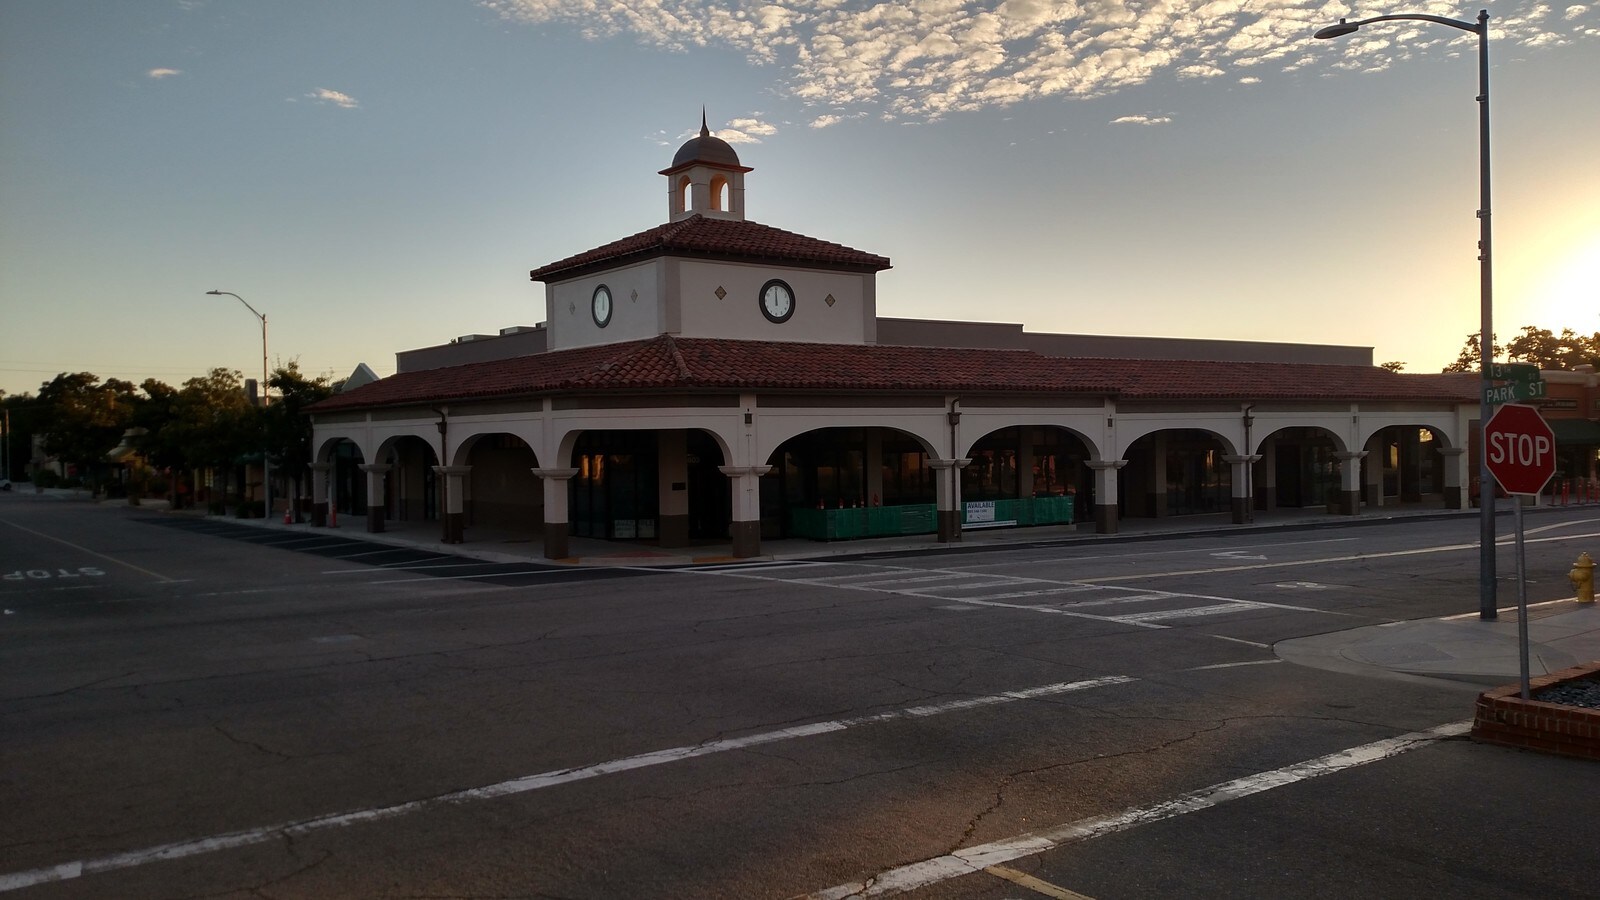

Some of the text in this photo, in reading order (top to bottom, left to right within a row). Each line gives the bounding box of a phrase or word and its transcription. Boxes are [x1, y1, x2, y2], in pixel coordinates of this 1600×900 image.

[1486, 381, 1543, 403] PARK ST
[1490, 431, 1550, 467] STOP
[968, 501, 994, 509] AVAILABLE
[3, 567, 106, 580] STOP
